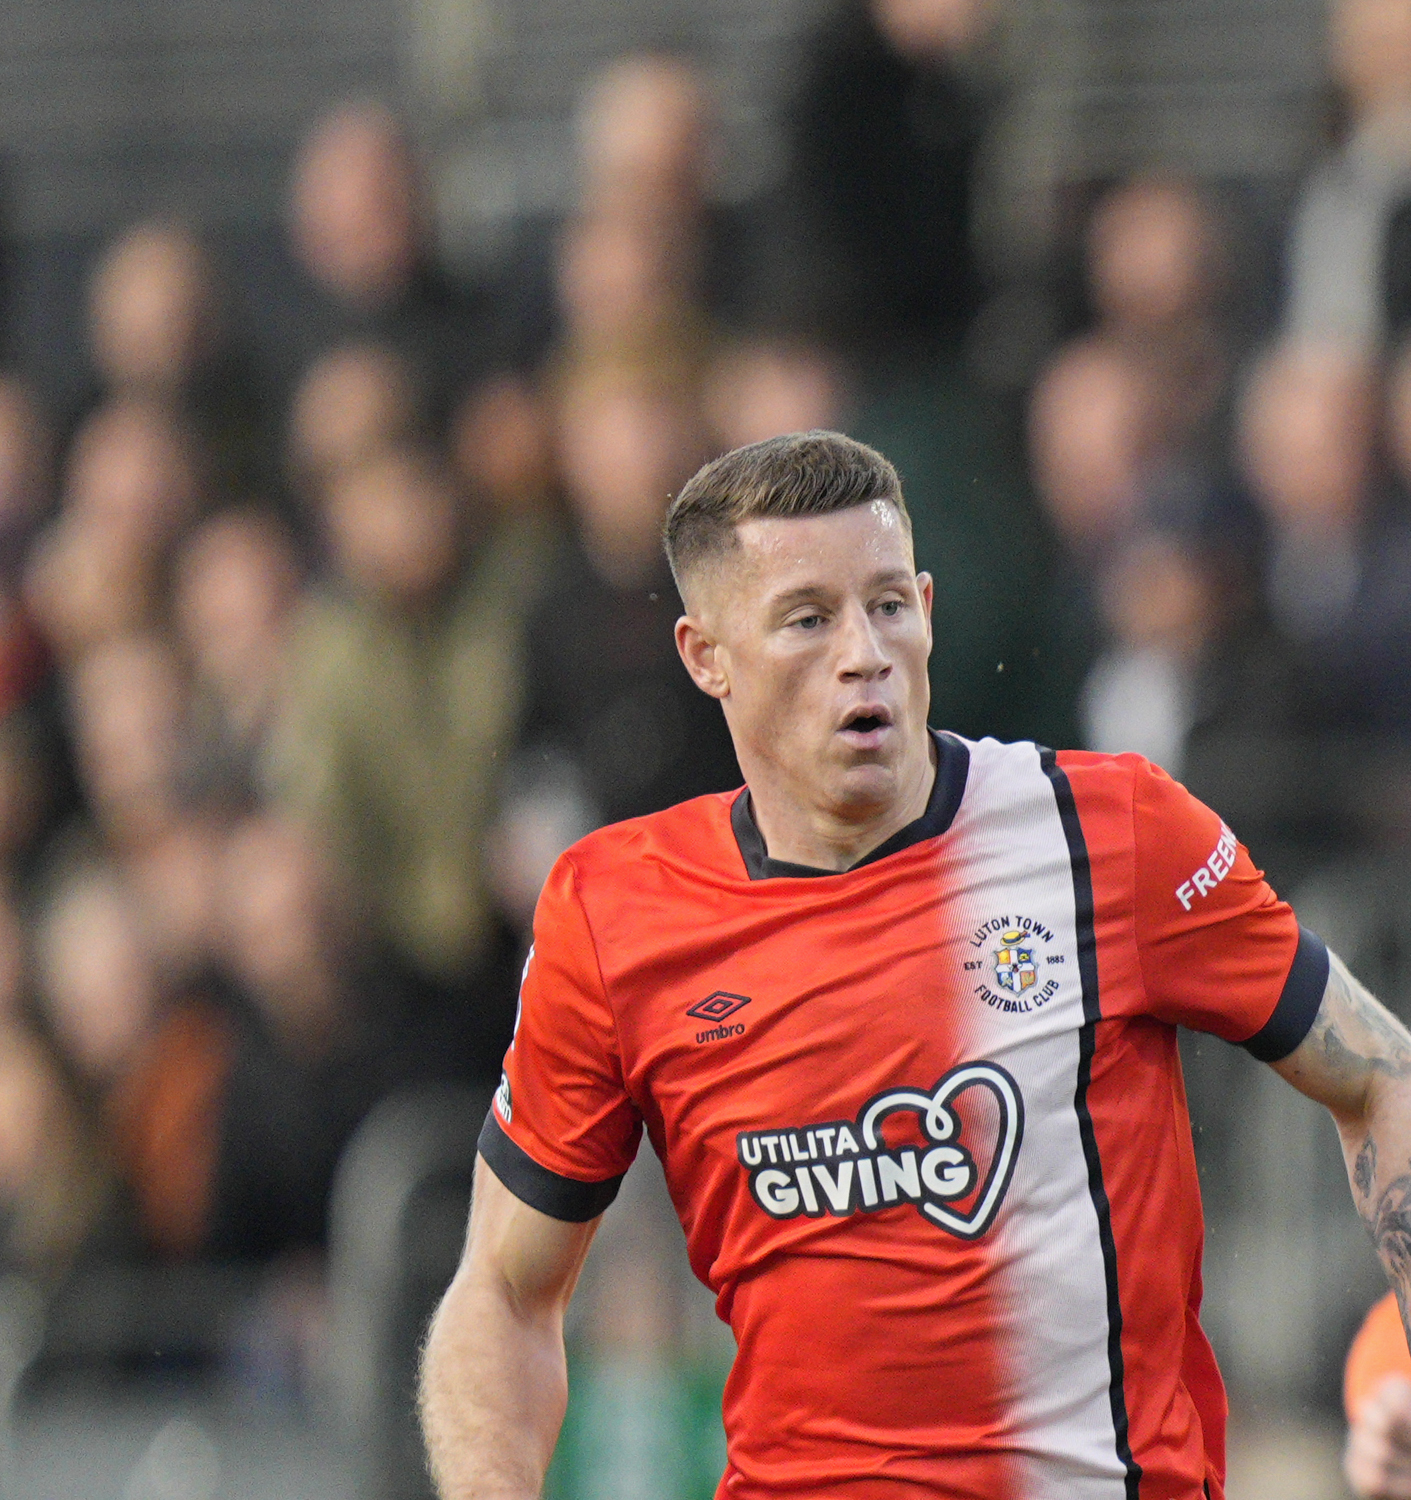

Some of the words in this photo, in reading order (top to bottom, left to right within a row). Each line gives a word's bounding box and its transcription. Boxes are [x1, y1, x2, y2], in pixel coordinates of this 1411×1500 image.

[1175, 818, 1236, 911] FREEN
[970, 916, 1010, 947] LUTON
[1016, 916, 1054, 942] TOWN
[964, 961, 982, 970] EST
[1046, 955, 1064, 964] 1885
[975, 984, 1032, 1013] FOOTBALL
[1033, 979, 1059, 1006] CLUB
[696, 1023, 745, 1044] umbro
[741, 1126, 859, 1165] UTILITA
[755, 1147, 970, 1214] GIVING
